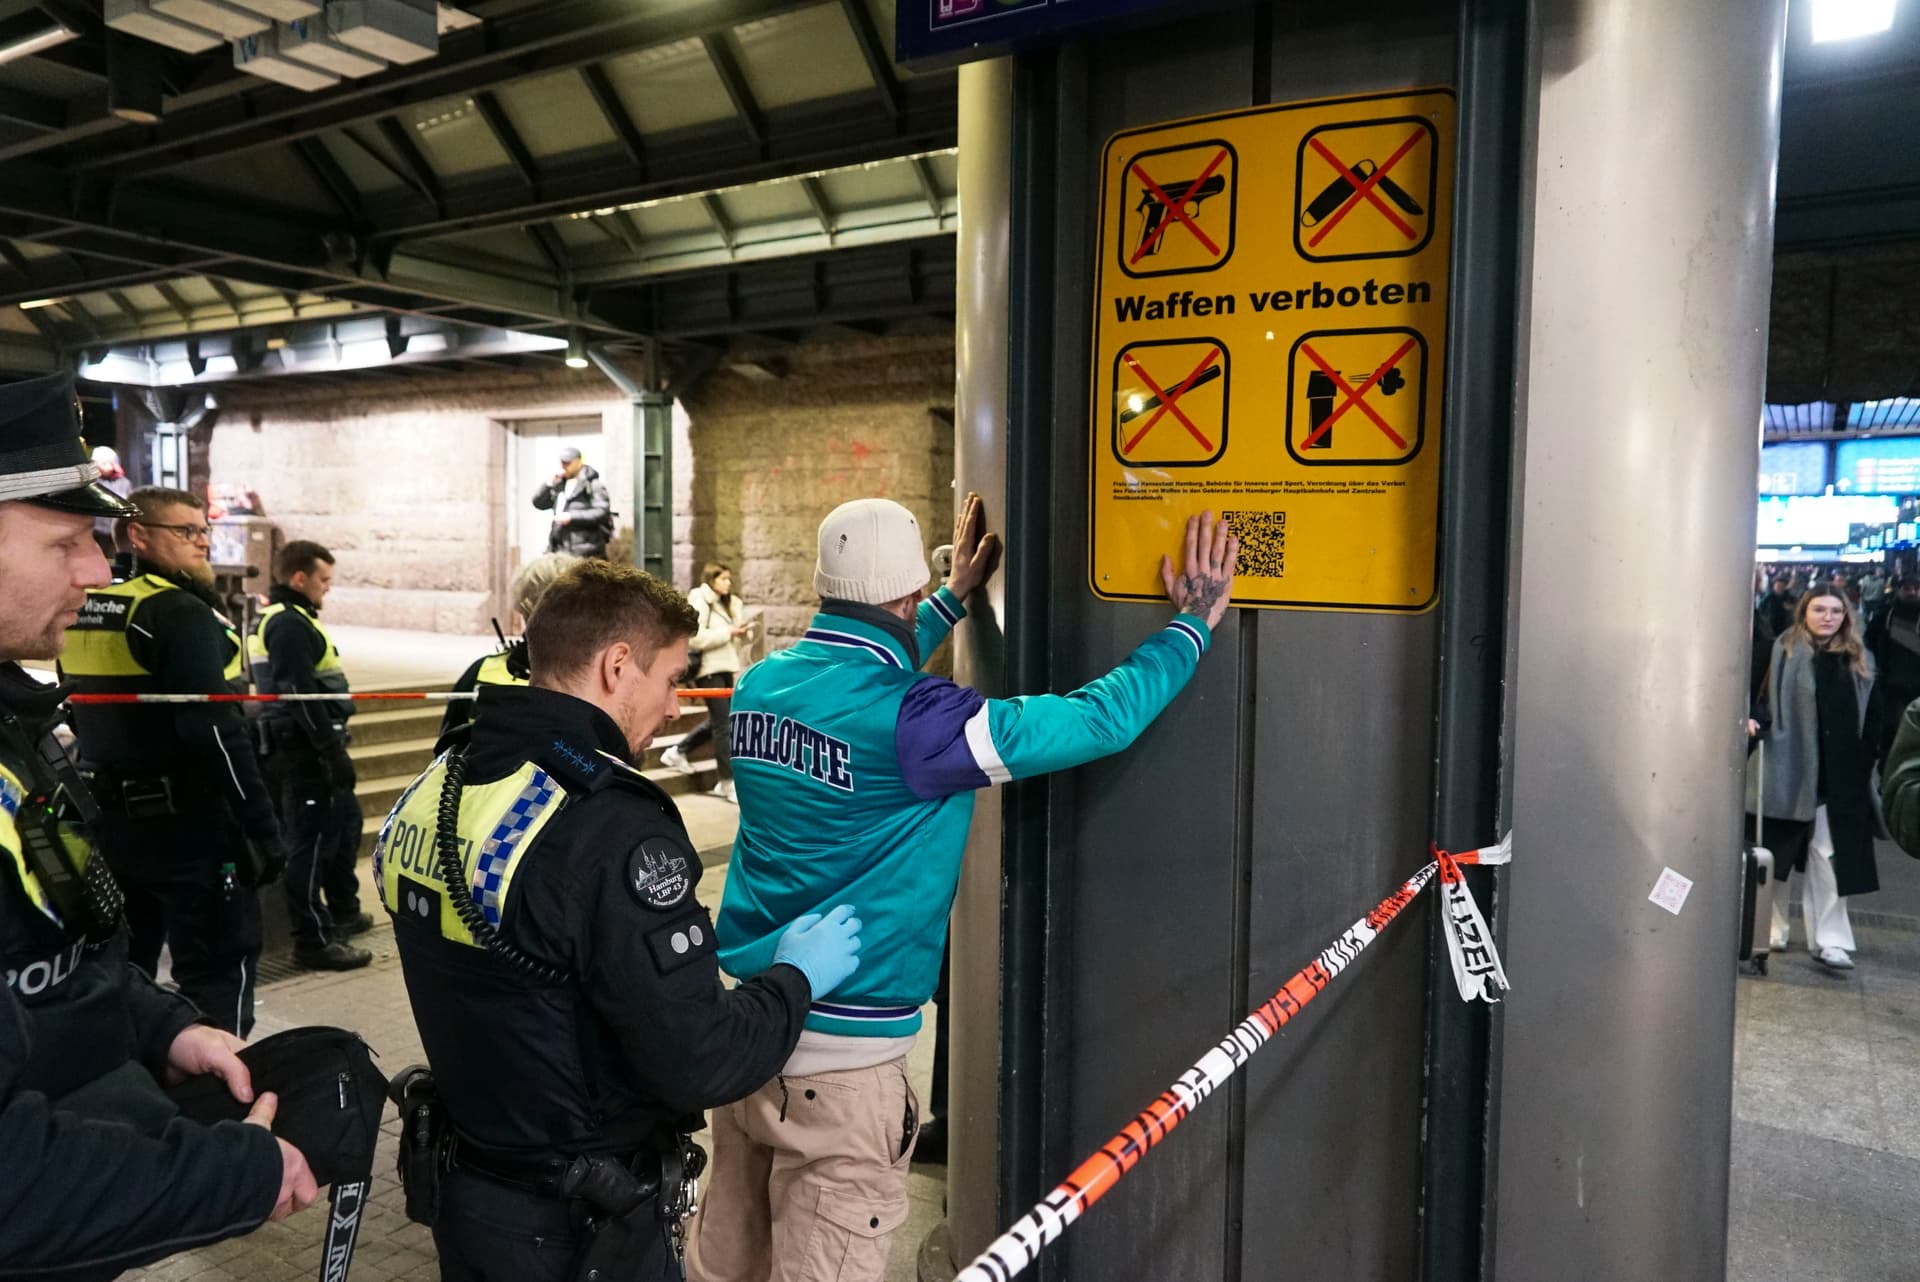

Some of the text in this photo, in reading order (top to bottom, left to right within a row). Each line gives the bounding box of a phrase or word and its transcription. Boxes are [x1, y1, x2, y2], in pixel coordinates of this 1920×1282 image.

[1114, 278, 1432, 323] Waffen verboten
[729, 710, 854, 792] ARLOTTE
[647, 873, 683, 894] Hamburg
